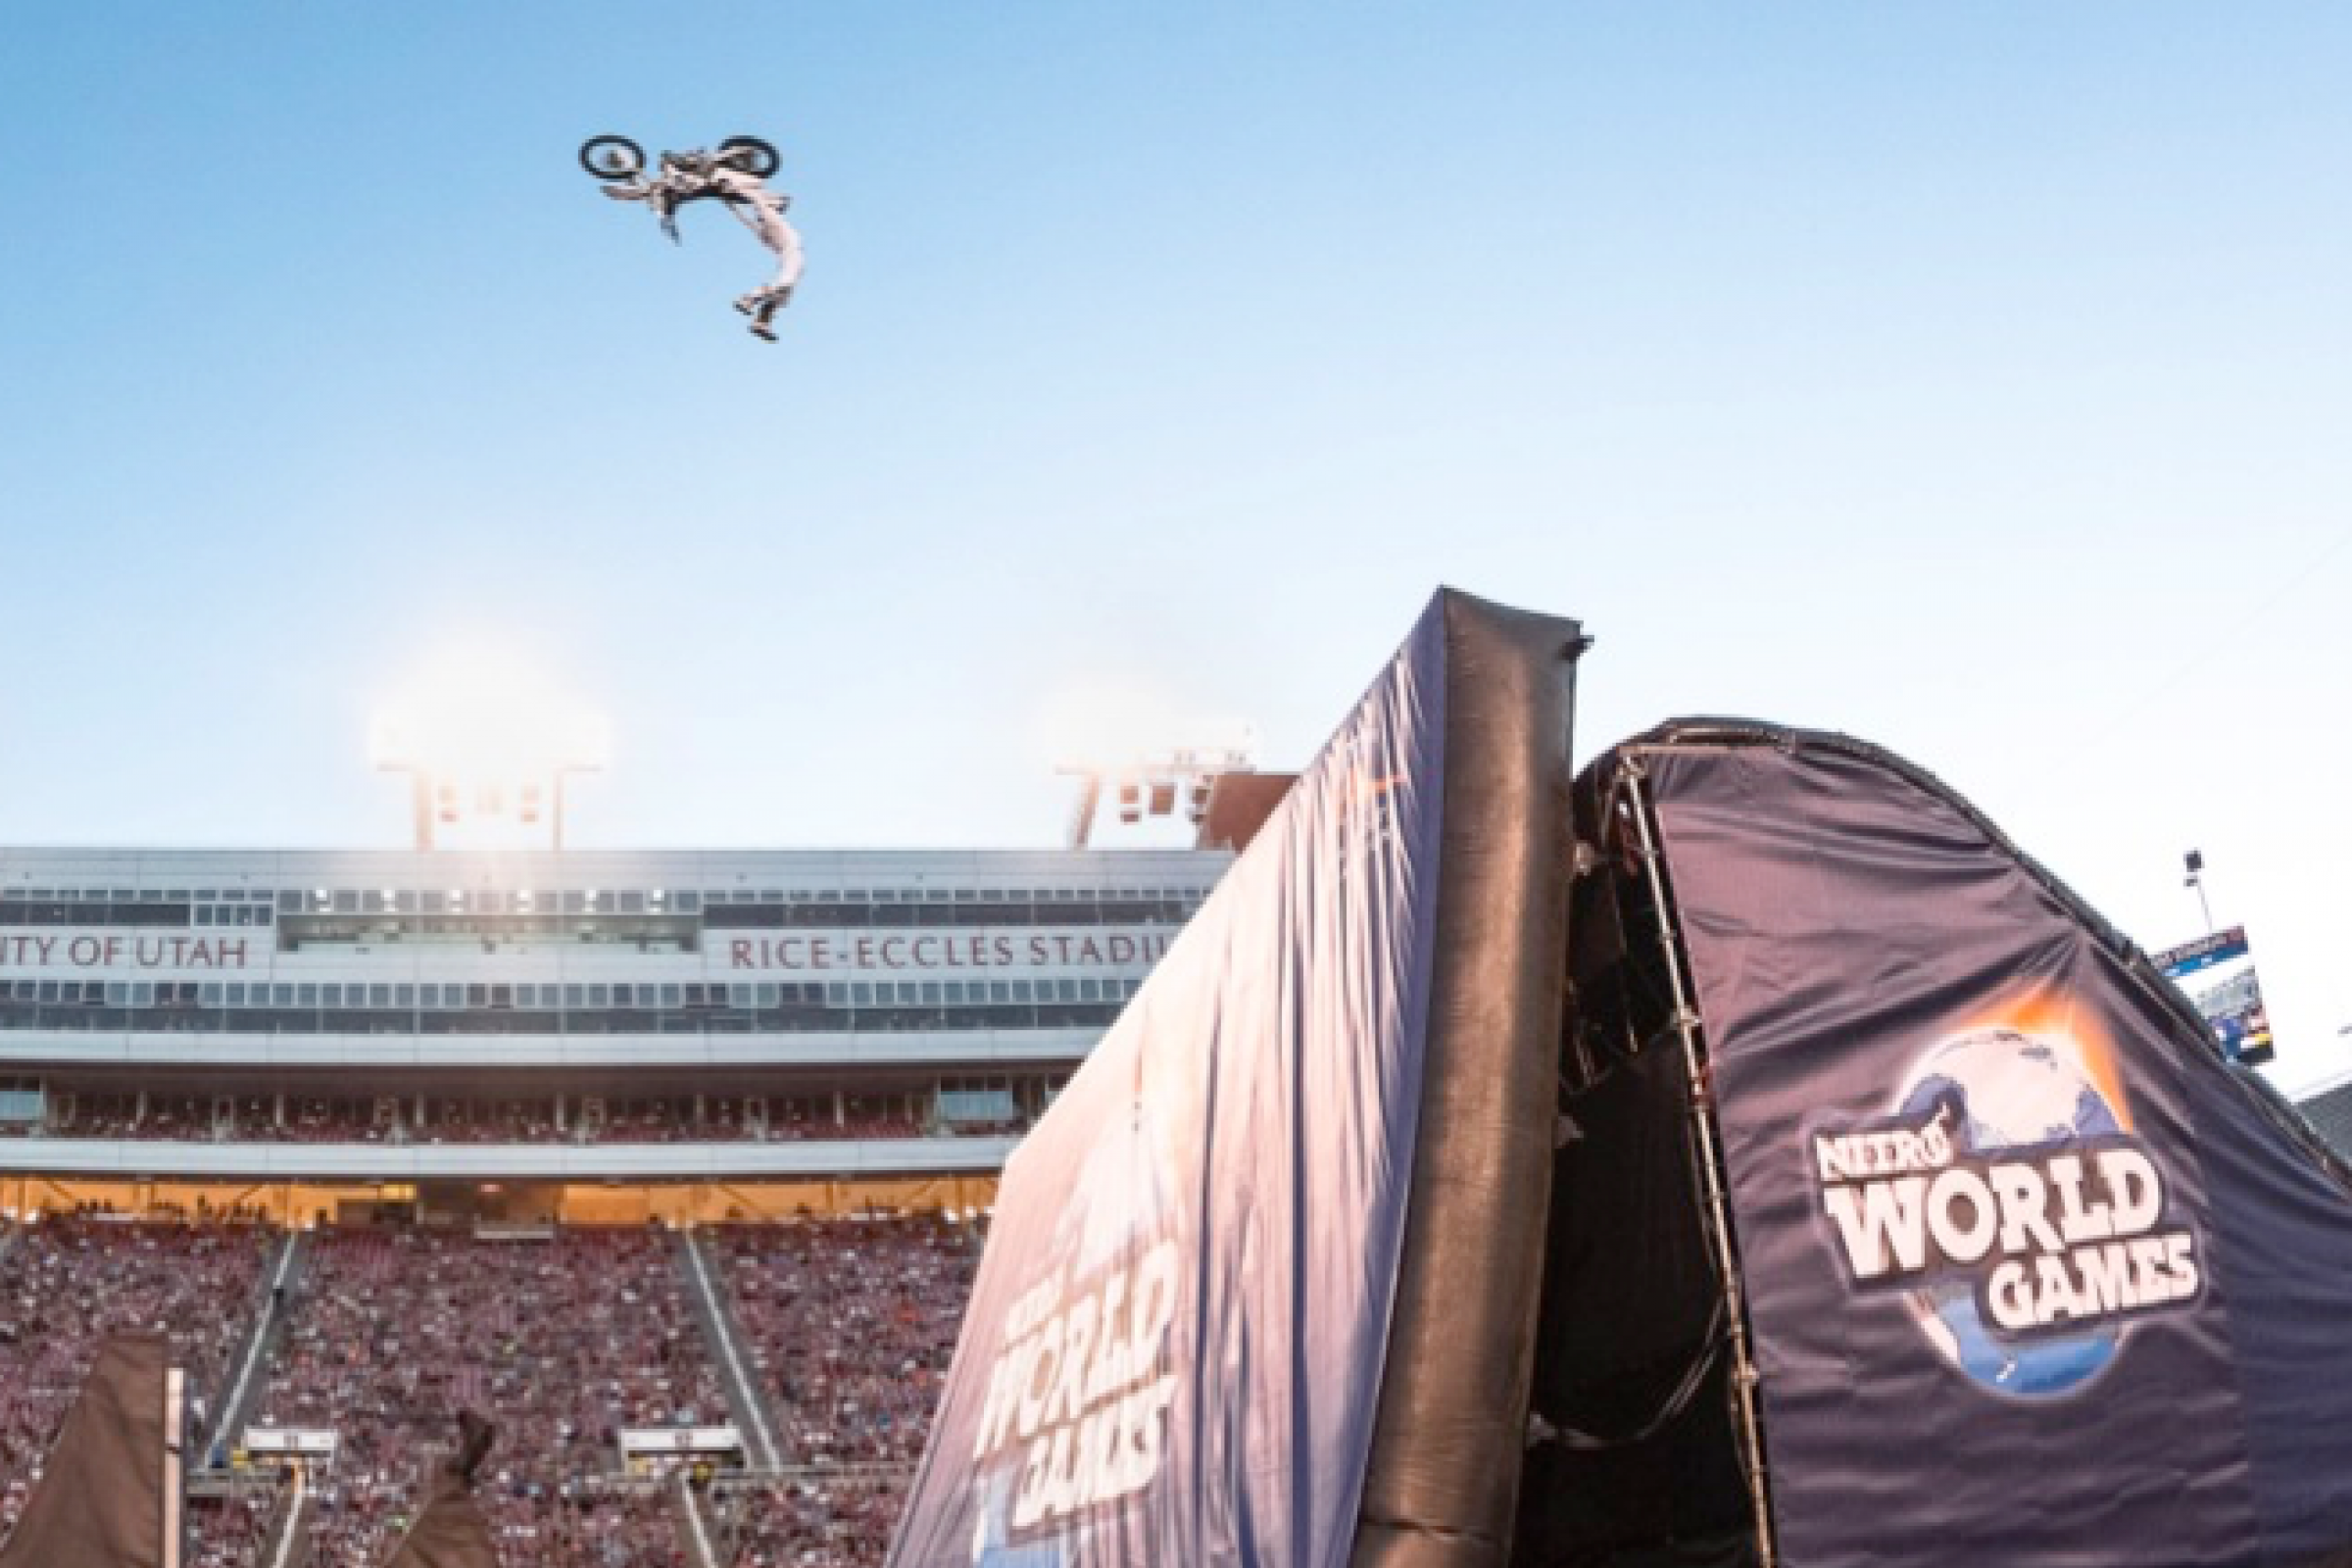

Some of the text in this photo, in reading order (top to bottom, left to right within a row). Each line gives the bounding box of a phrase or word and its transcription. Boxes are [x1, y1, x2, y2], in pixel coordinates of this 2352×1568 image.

[68, 935, 123, 966] OF
[135, 935, 248, 969] UTAH
[729, 935, 1014, 970] RICE-ECCLES
[1816, 1119, 1954, 1182] NITRO
[1824, 1149, 2163, 1278] WORLD
[1988, 1232, 2199, 1329] GAMES
[973, 1239, 1178, 1460] WORLD
